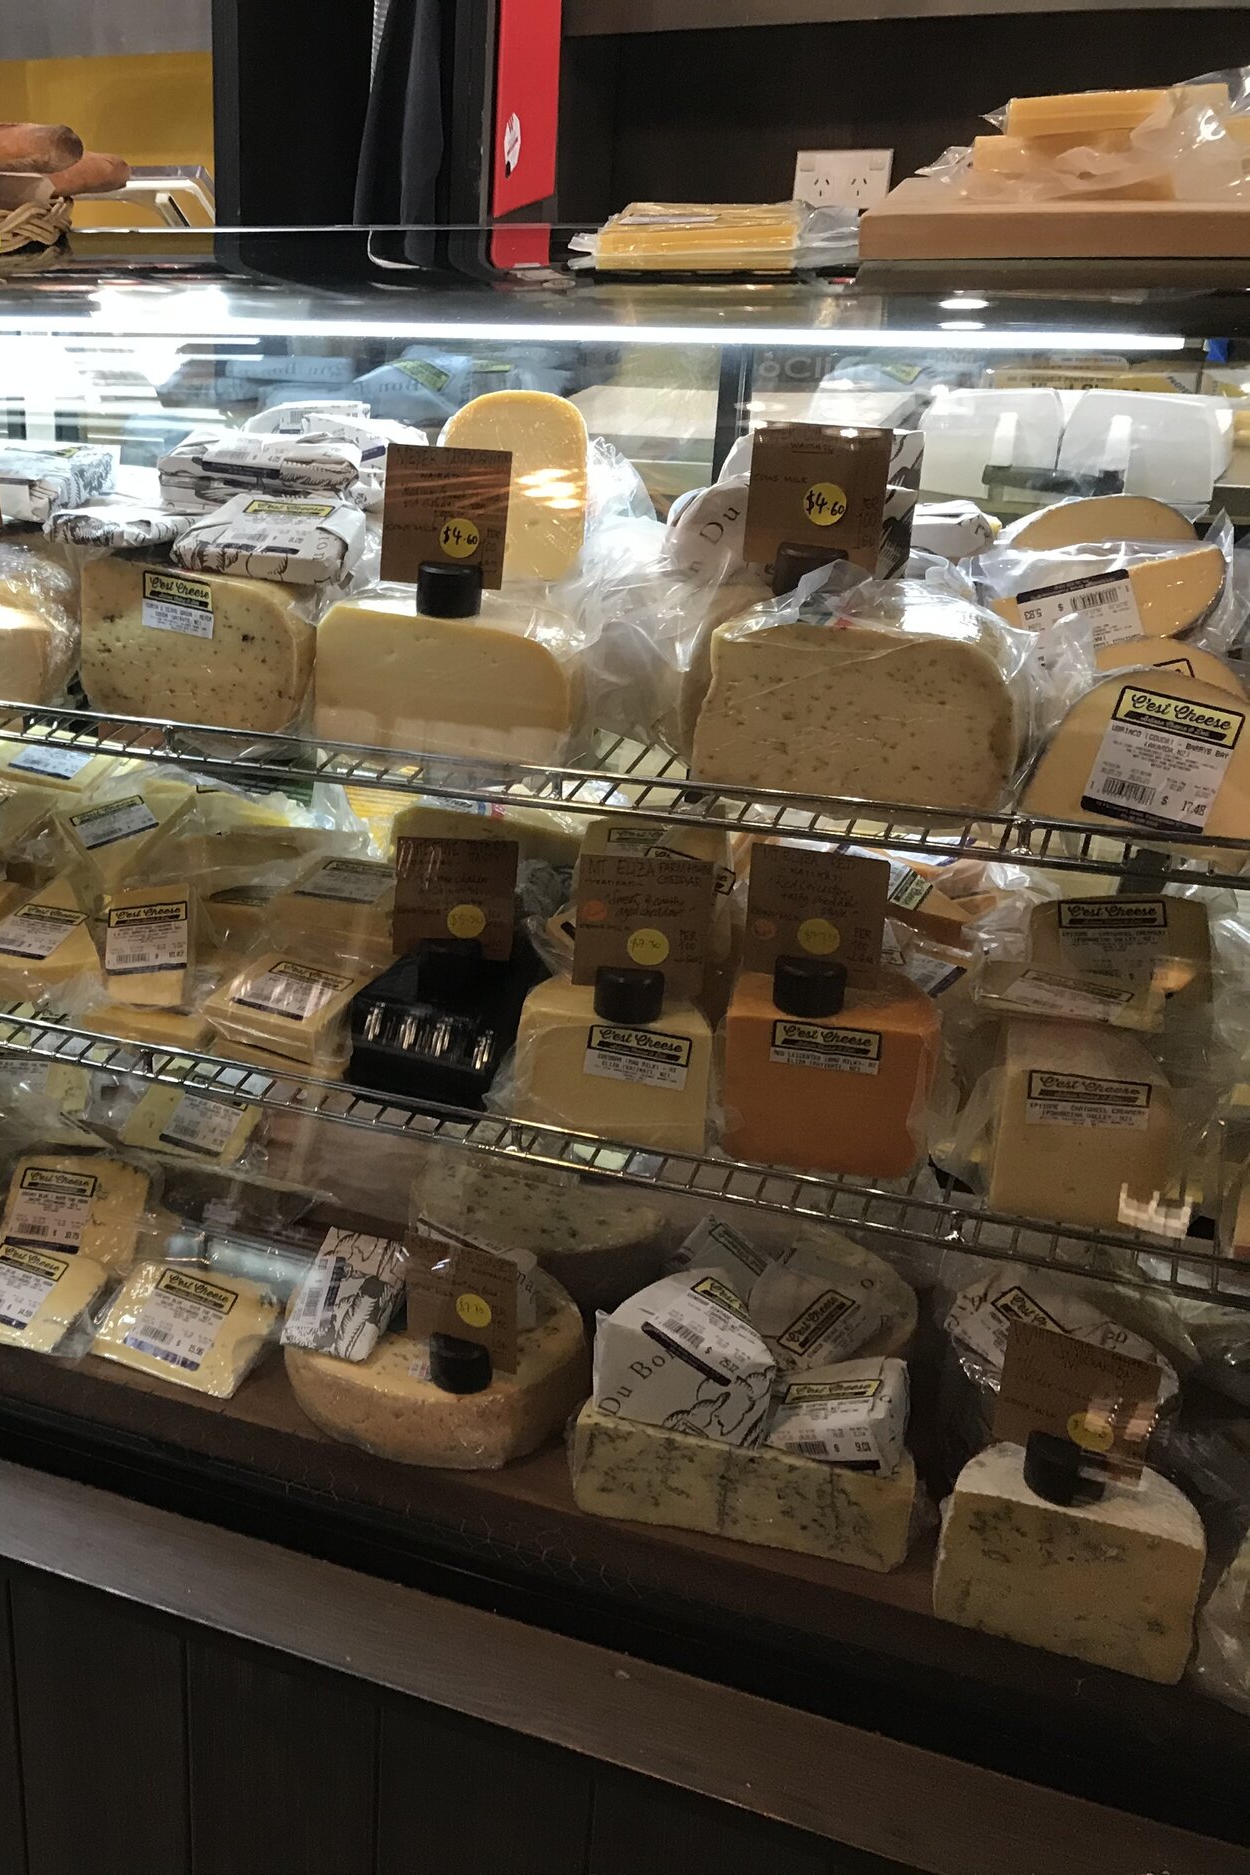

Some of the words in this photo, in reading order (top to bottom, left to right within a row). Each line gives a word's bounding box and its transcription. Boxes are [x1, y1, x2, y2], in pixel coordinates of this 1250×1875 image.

[806, 489, 845, 516] $4.60
[443, 527, 478, 545] $4.60
[176, 581, 210, 600] Cheese
[1131, 693, 1172, 715] C'est
[1174, 704, 1232, 730] Cheese
[1215, 750, 1229, 759] BAY
[1182, 800, 1207, 816] 17.48
[1105, 905, 1157, 917] Cheese
[599, 1029, 633, 1043] C'est
[634, 1034, 684, 1053] Cheese
[783, 1025, 819, 1040] C'est
[820, 1031, 873, 1047] Cheese
[1040, 1076, 1080, 1089] C'est
[1081, 1080, 1141, 1095] Cheese
[598, 1385, 632, 1416] Du
